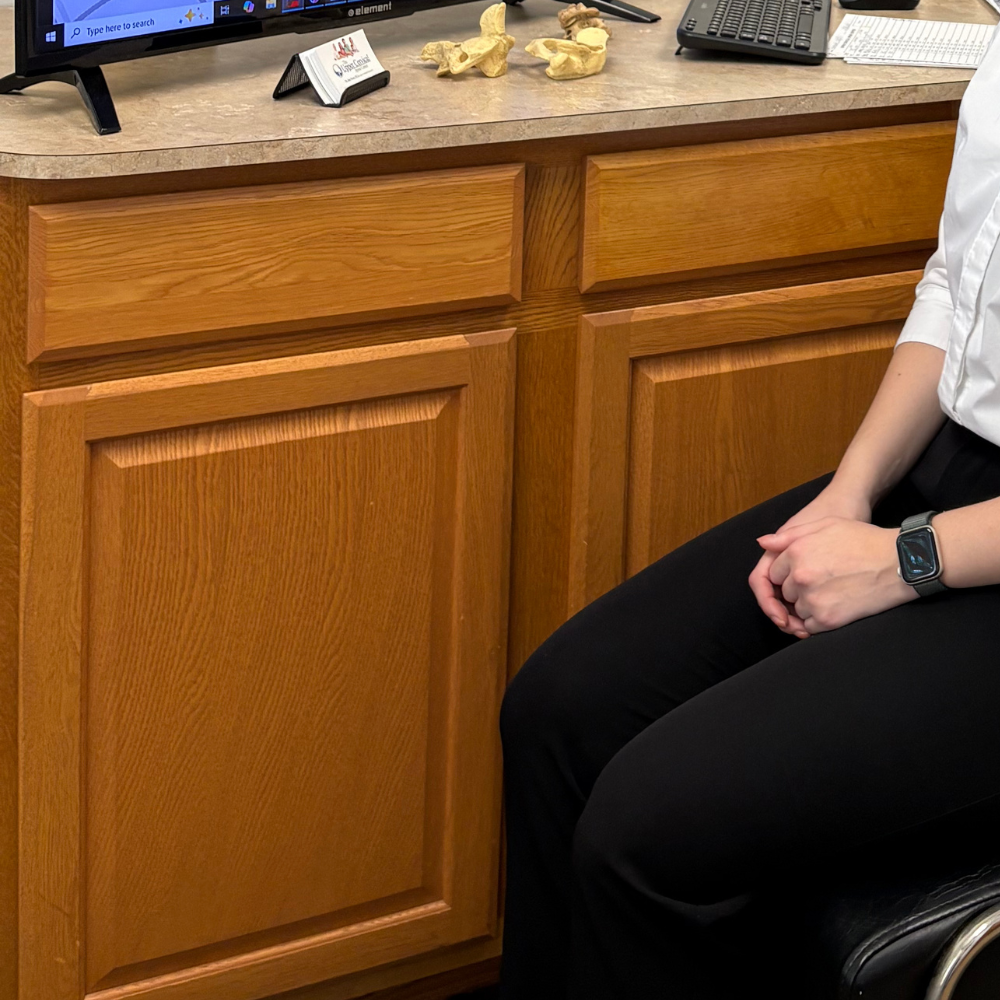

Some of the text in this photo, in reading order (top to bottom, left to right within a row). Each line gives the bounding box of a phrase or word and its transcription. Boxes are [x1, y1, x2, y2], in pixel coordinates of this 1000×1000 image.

[355, 0, 392, 16] element
[86, 18, 155, 37] Type here to search
